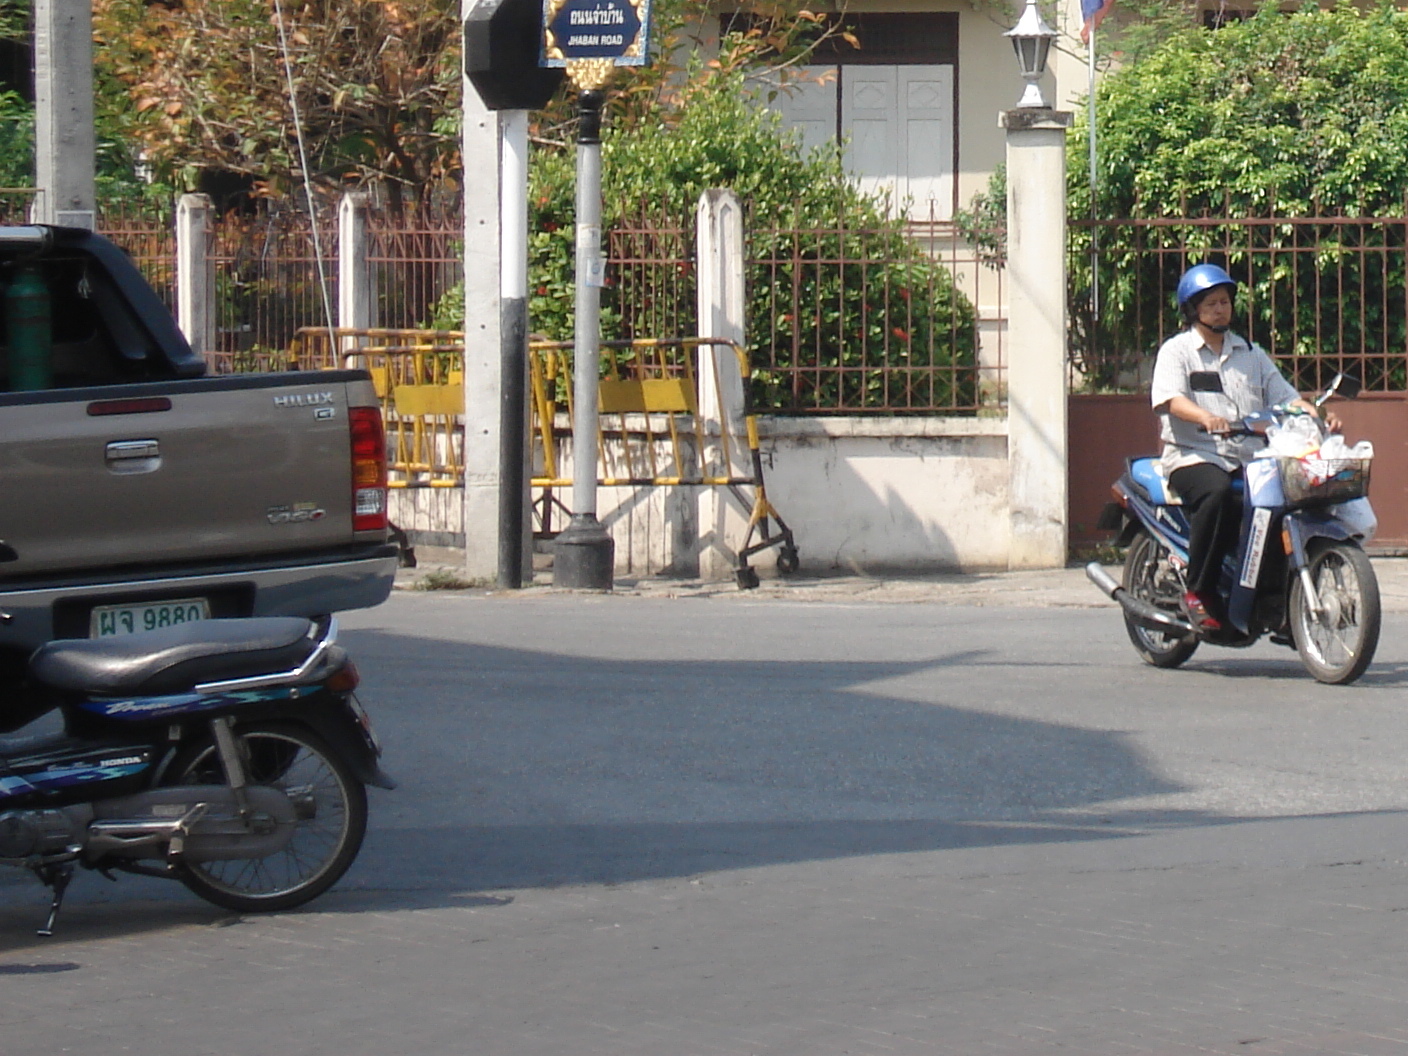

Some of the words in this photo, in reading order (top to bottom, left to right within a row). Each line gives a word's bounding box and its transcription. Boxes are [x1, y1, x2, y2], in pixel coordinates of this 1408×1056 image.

[570, 2, 624, 25] ถนนจ่าบ้าน
[567, 35, 599, 46] JHABAN
[601, 34, 623, 46] ROAD
[273, 391, 334, 408] HILUX
[99, 756, 142, 768] HONDA
